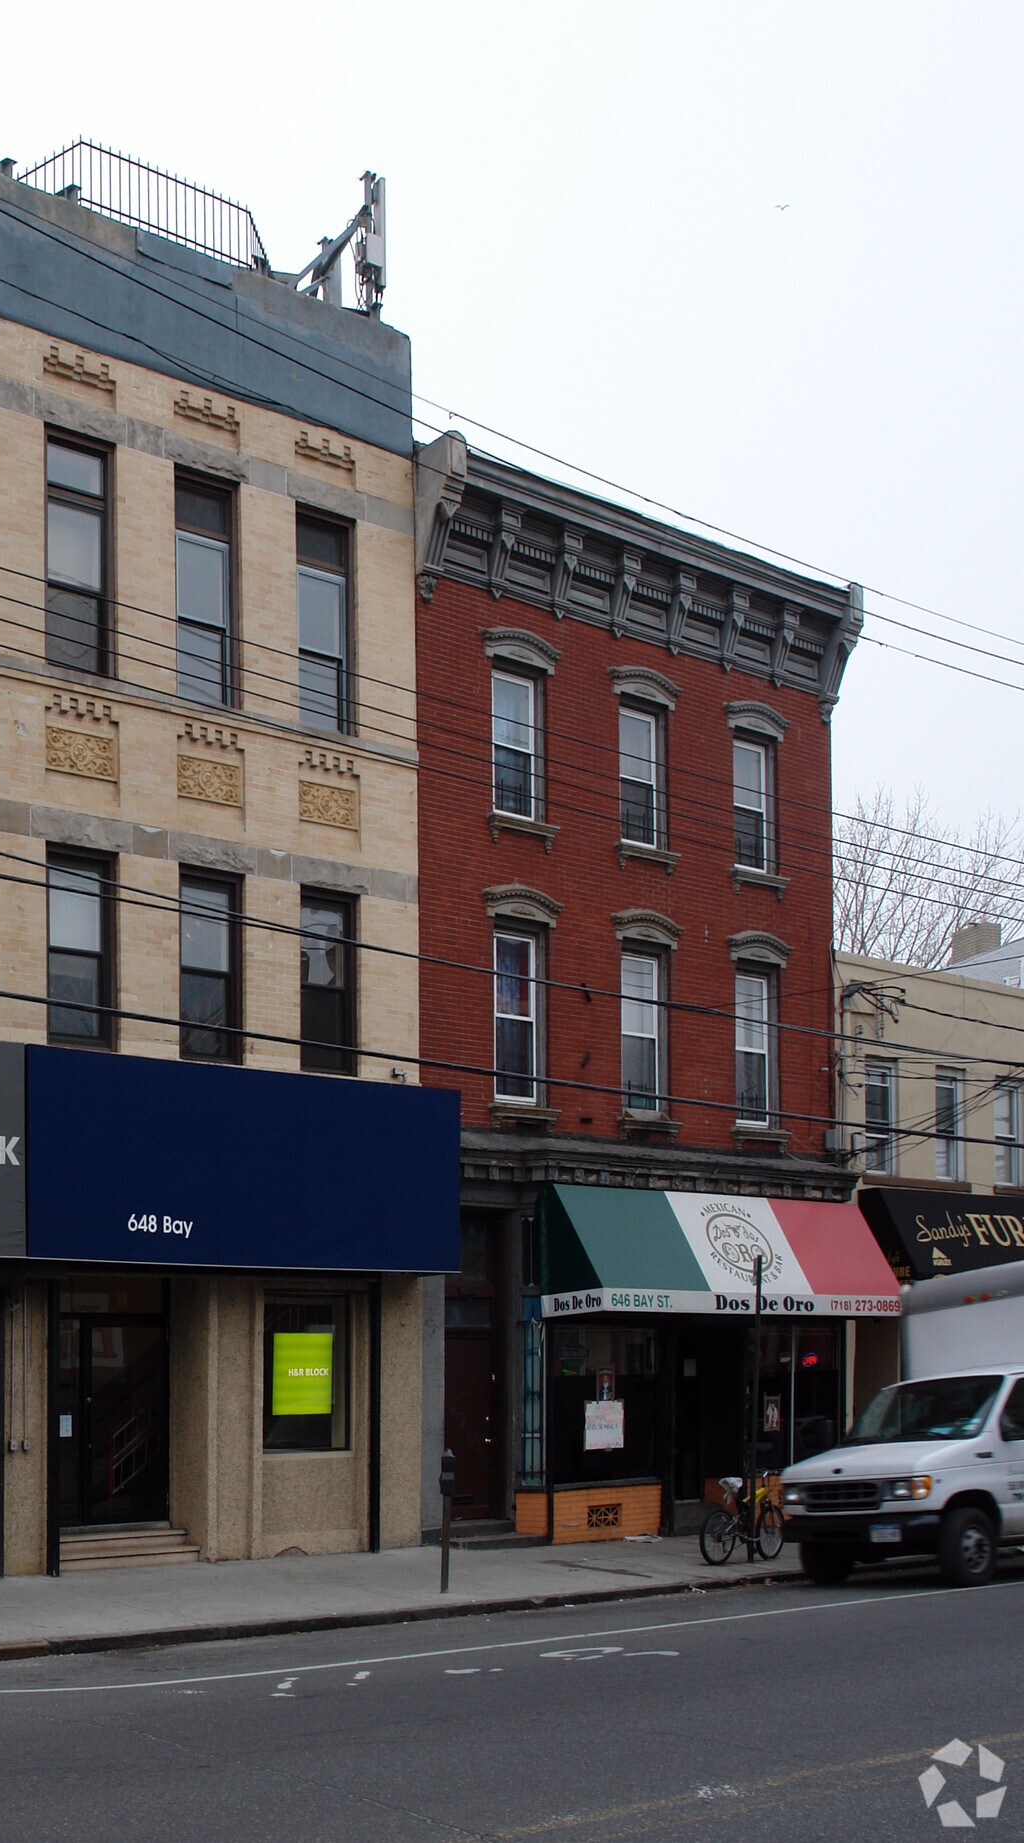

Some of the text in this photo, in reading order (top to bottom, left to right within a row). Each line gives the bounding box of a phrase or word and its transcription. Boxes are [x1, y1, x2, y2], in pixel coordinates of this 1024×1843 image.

[702, 1202, 747, 1218] MEXICAN
[127, 1213, 194, 1239] 648 Bay
[915, 1210, 1024, 1248] Sandy's FUR
[710, 1251, 772, 1286] RESTAURNT
[553, 1293, 602, 1312] Dos De Oro
[611, 1293, 673, 1309] 646 BAY ST.
[714, 1294, 750, 1311] Dos
[783, 1295, 815, 1312] Oro
[830, 1299, 901, 1313] (718) 273-0869
[288, 1367, 329, 1377] H&R BLOCK
